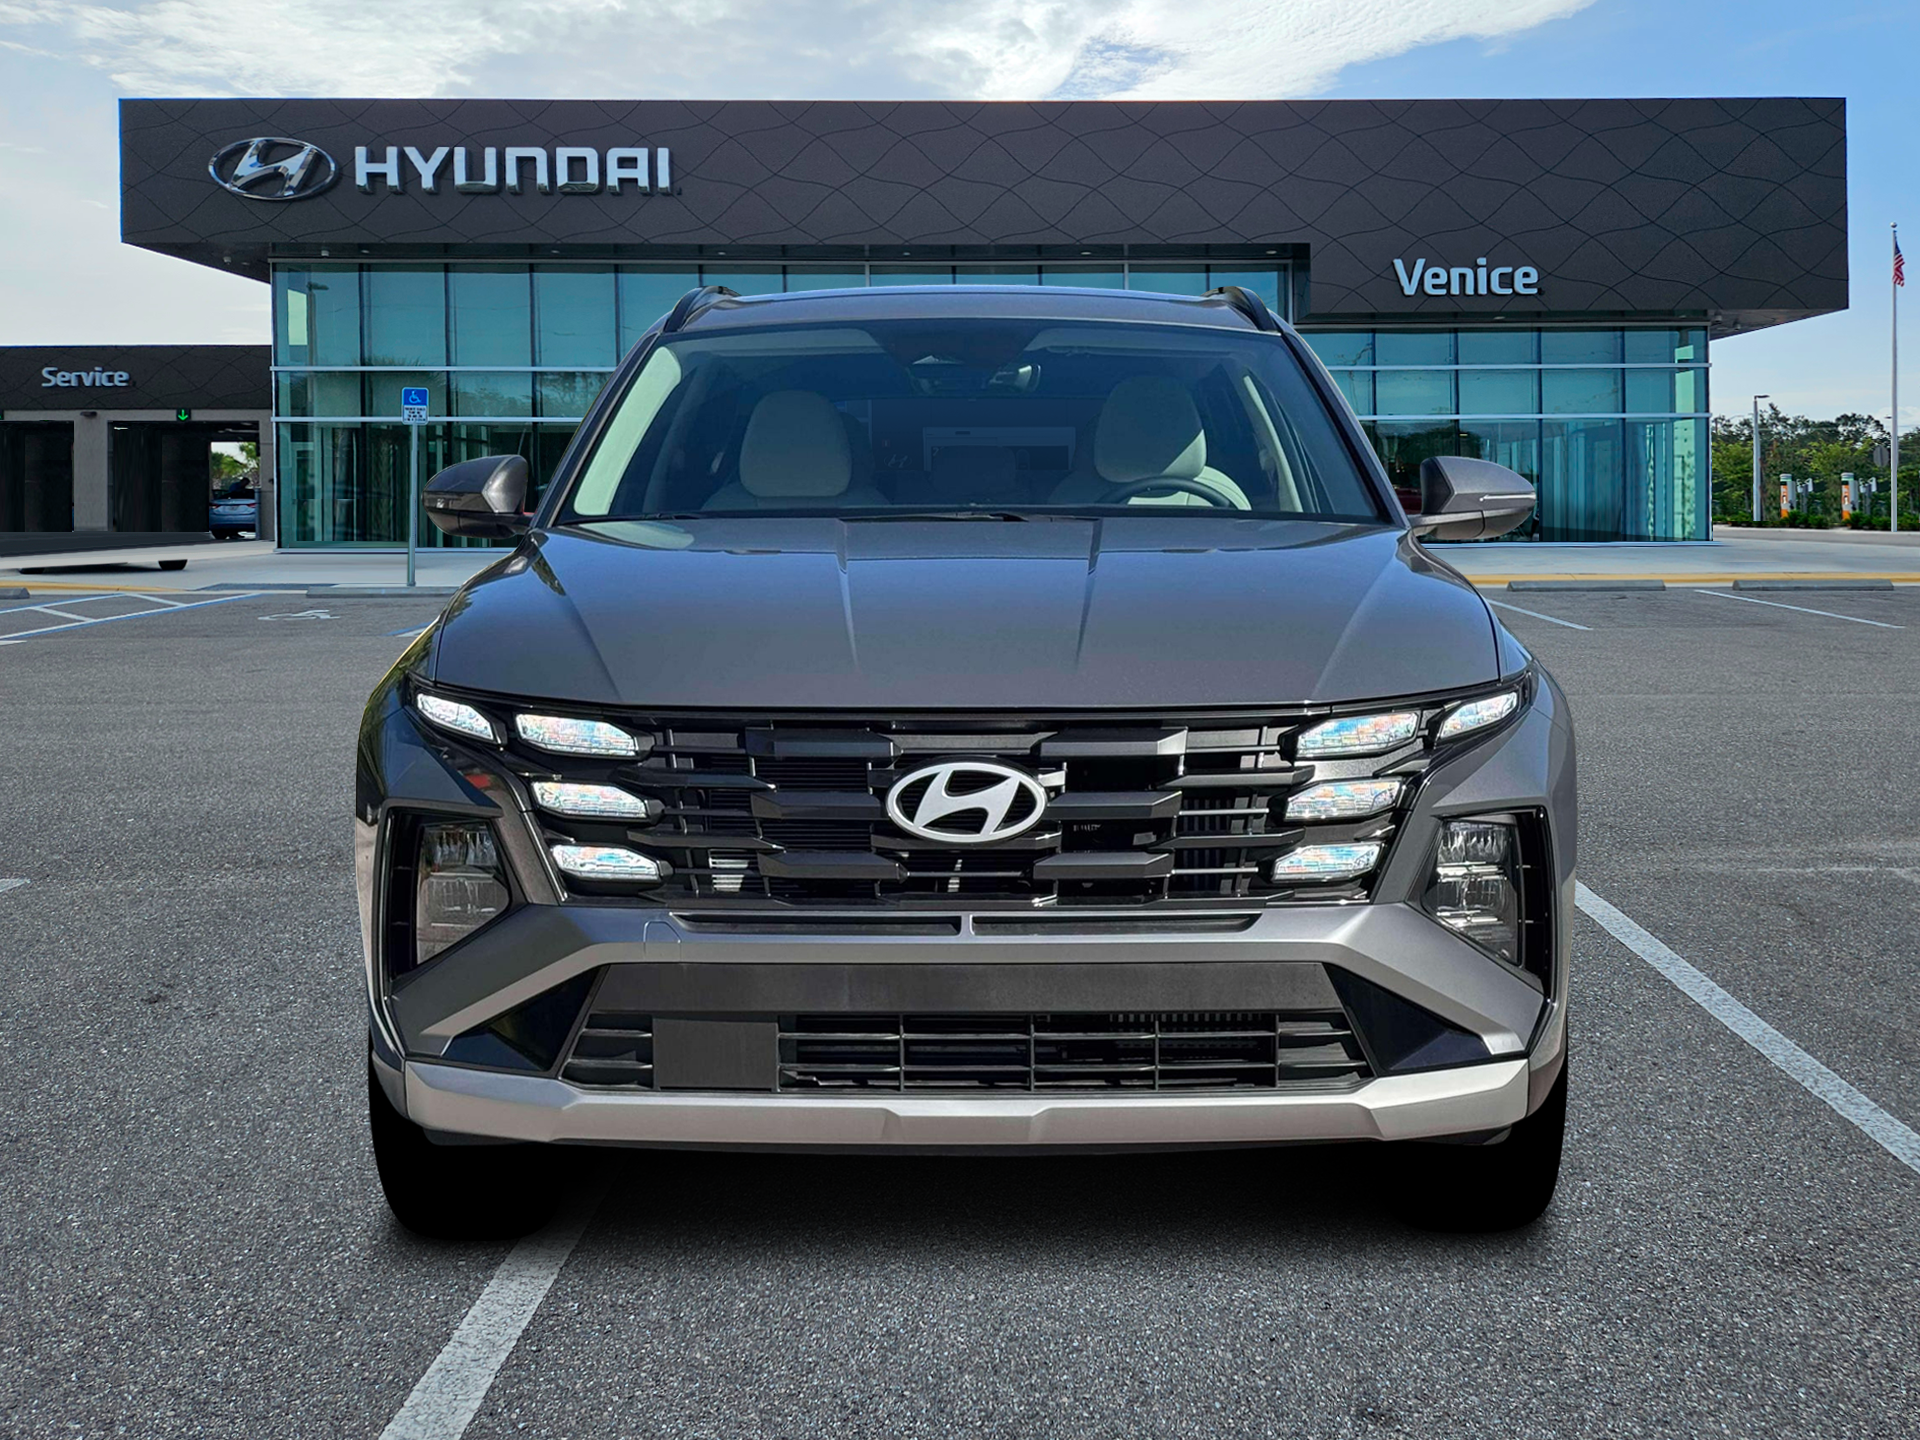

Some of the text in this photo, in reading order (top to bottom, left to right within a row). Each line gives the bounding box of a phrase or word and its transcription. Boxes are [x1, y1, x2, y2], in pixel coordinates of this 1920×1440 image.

[354, 146, 672, 194] HYUNDAI
[1393, 256, 1539, 296] Venice
[41, 366, 130, 387] Service
